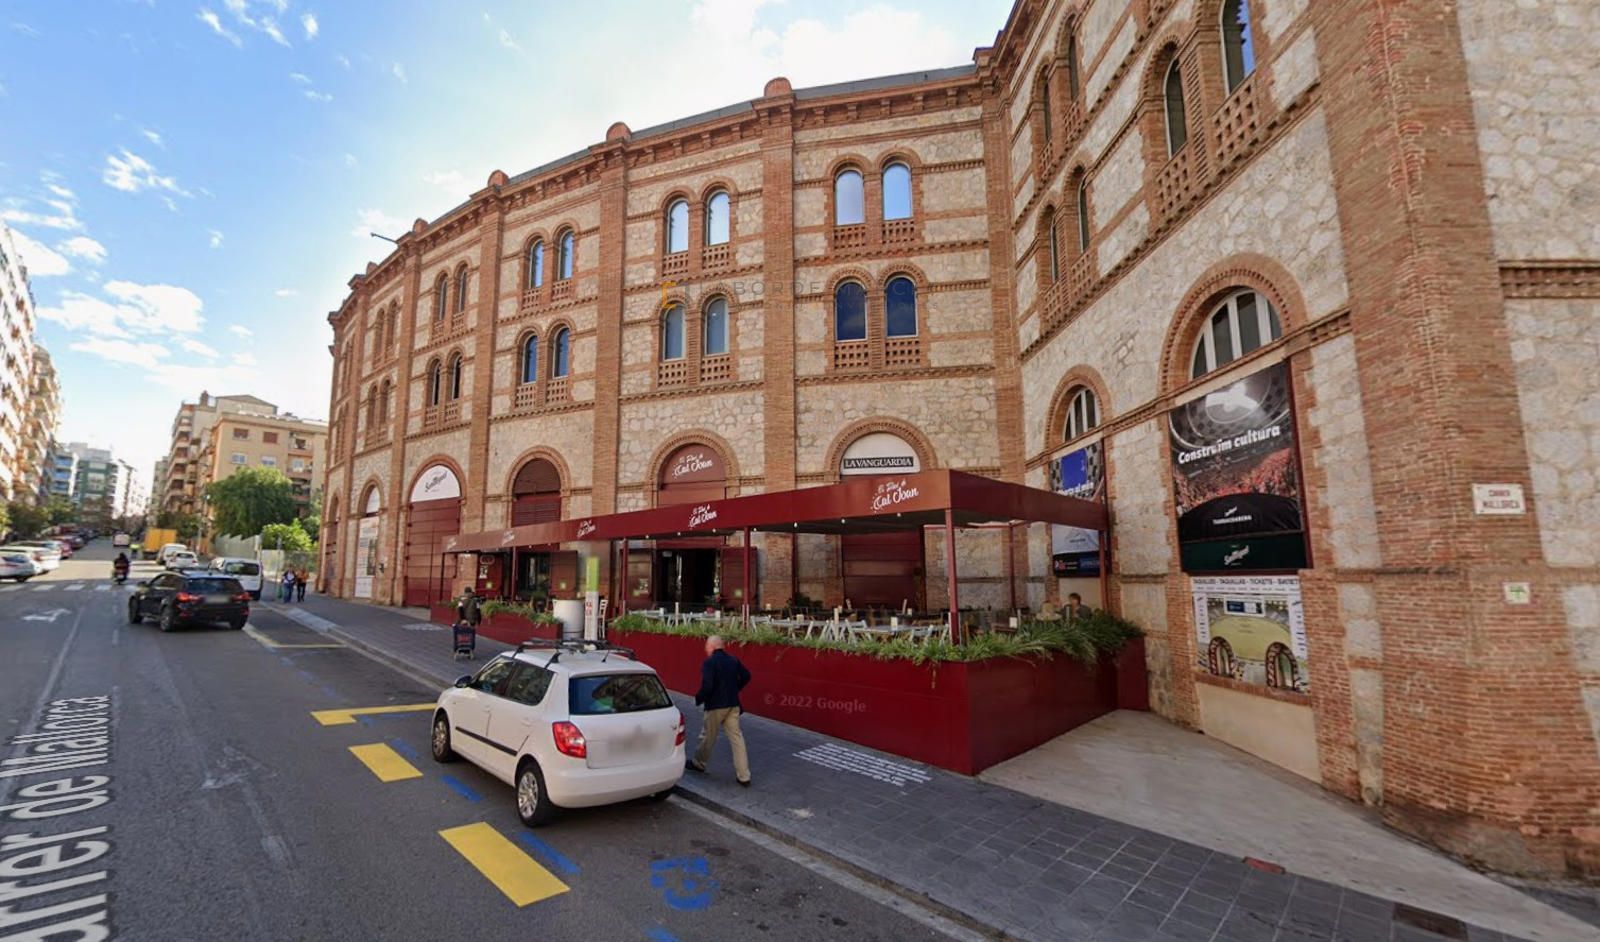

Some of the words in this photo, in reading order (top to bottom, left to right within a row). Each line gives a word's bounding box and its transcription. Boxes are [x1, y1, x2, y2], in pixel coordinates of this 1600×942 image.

[1234, 425, 1281, 448] cultura
[855, 457, 912, 468] VANGUARDIA
[873, 494, 892, 511] Cal
[893, 487, 919, 504] Joan
